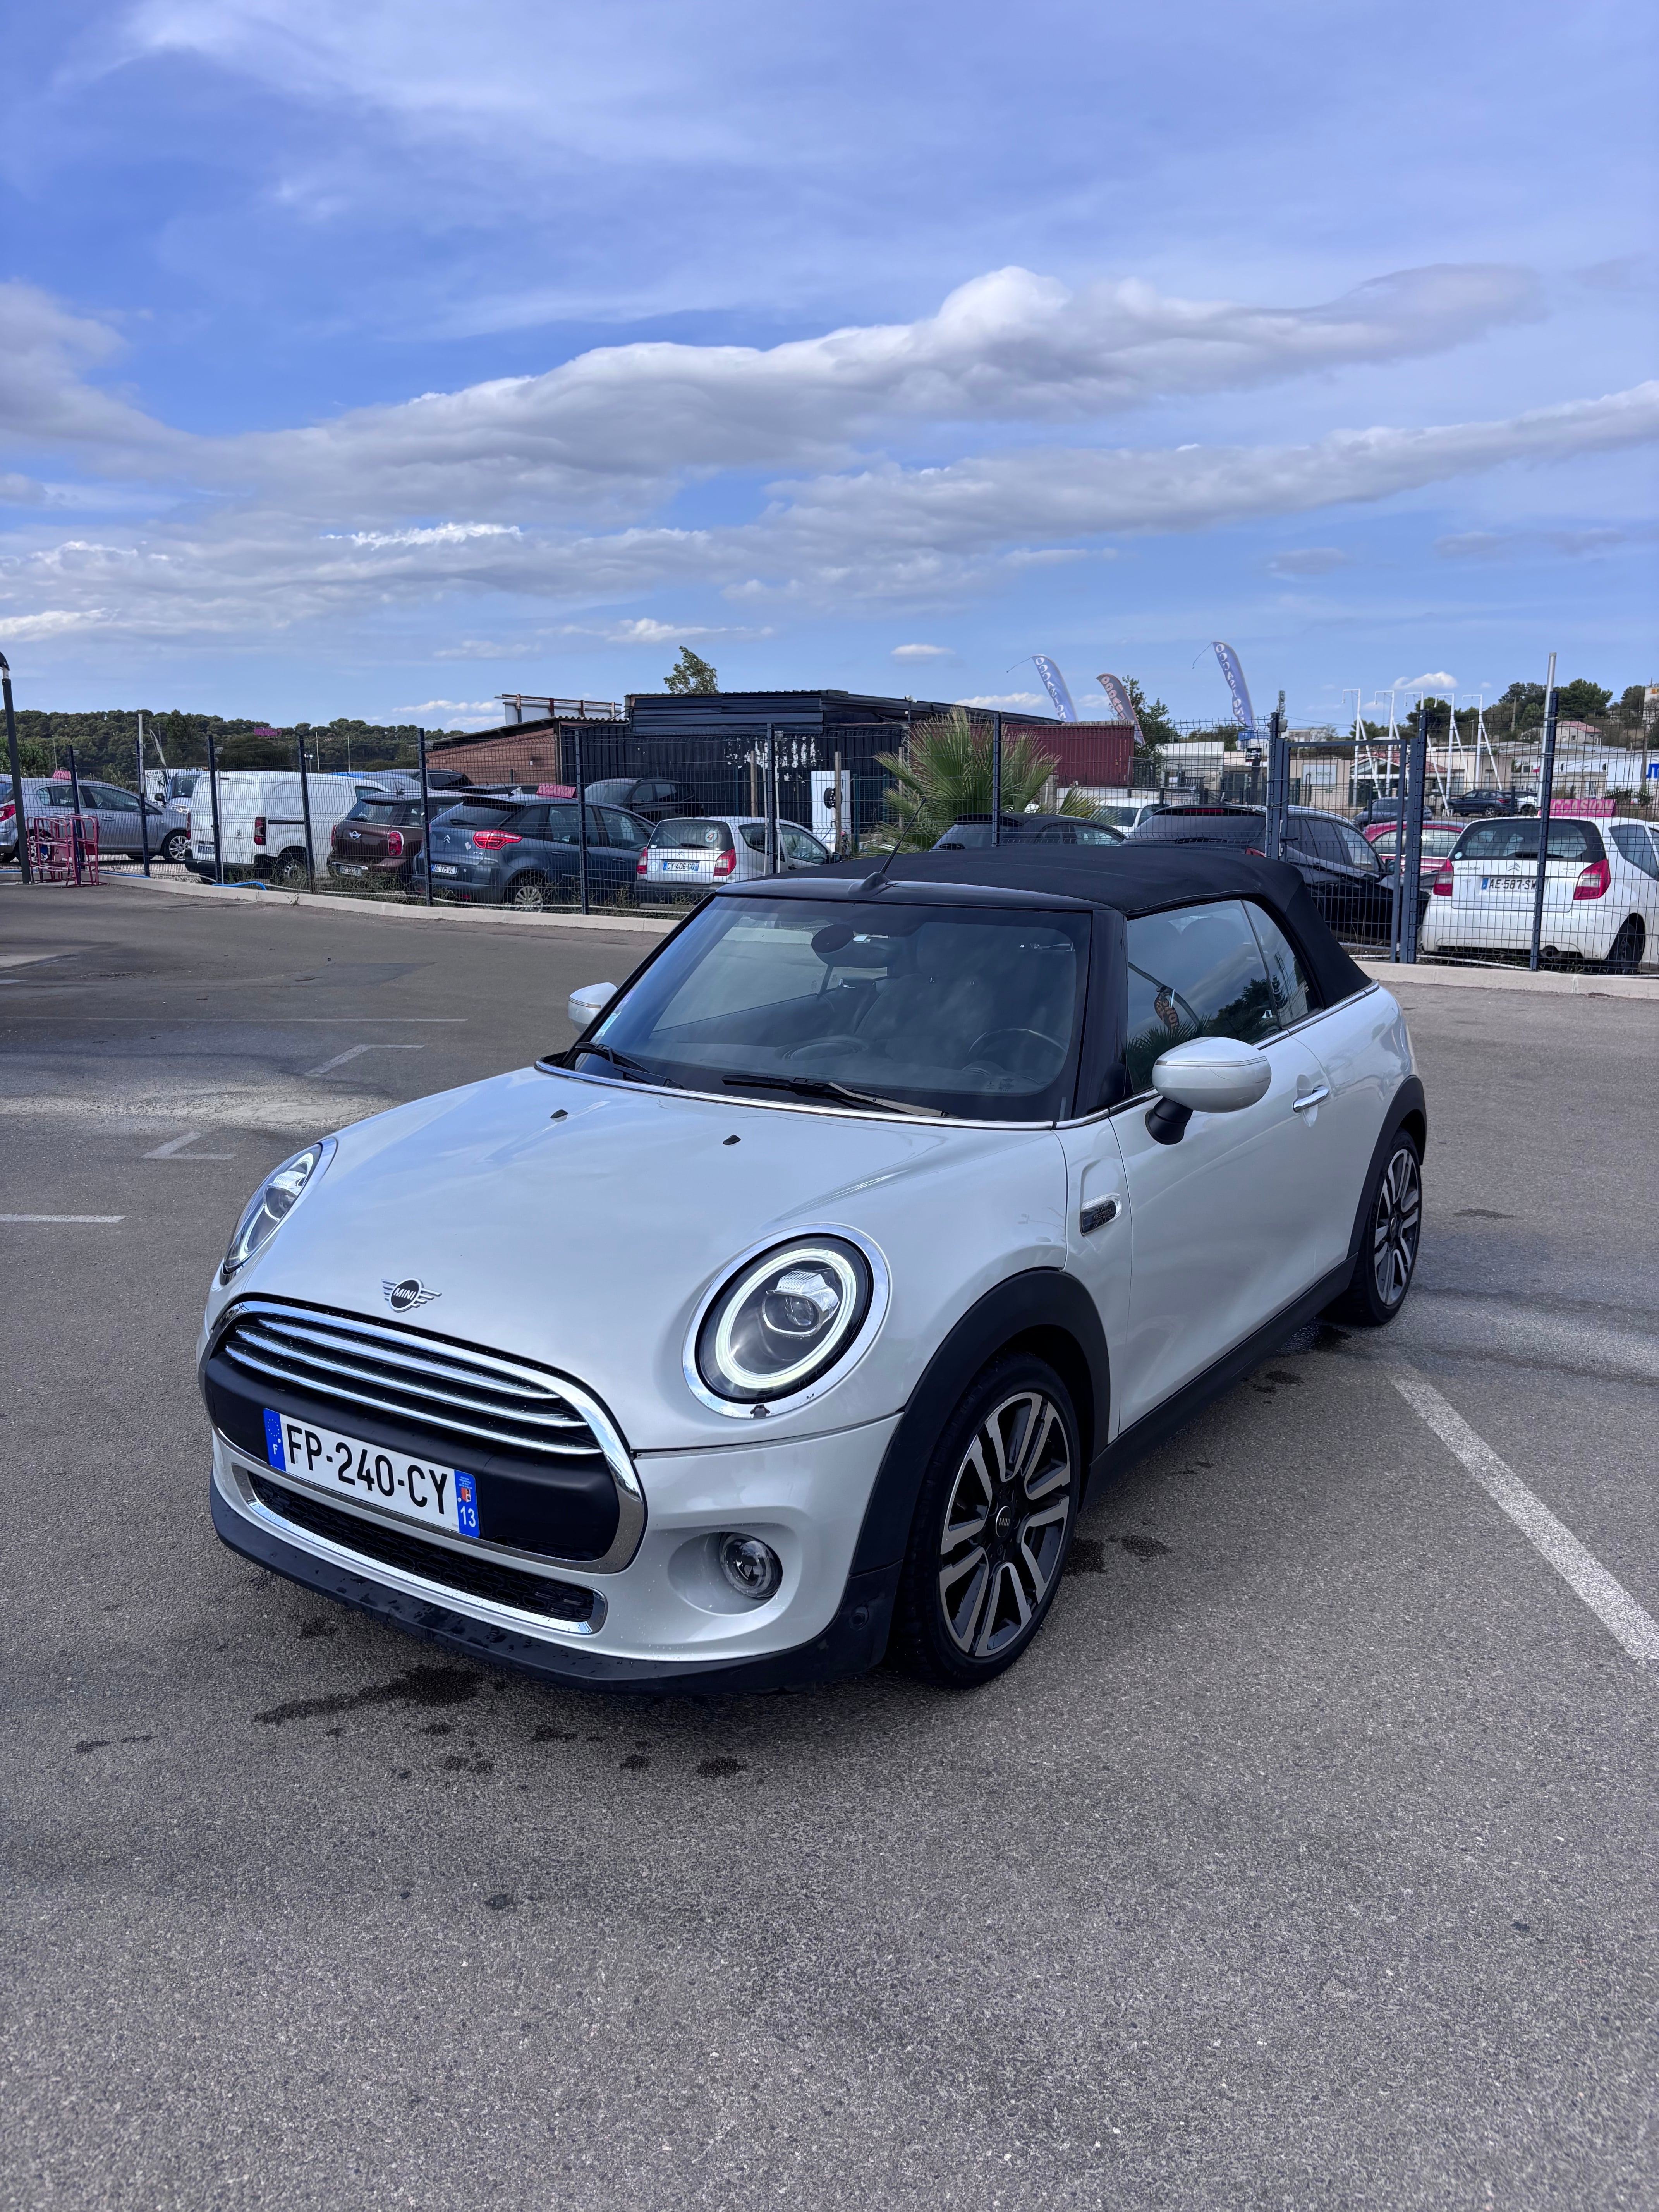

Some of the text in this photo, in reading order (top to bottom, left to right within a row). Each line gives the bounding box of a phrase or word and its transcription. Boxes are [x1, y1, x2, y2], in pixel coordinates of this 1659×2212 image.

[1550, 799, 1613, 814] CCASION
[393, 1287, 417, 1300] MINI
[273, 1443, 278, 1455] F
[287, 1424, 447, 1514] FP-240-CY
[460, 1506, 476, 1528] 13
[999, 1517, 1010, 1526] MINI
